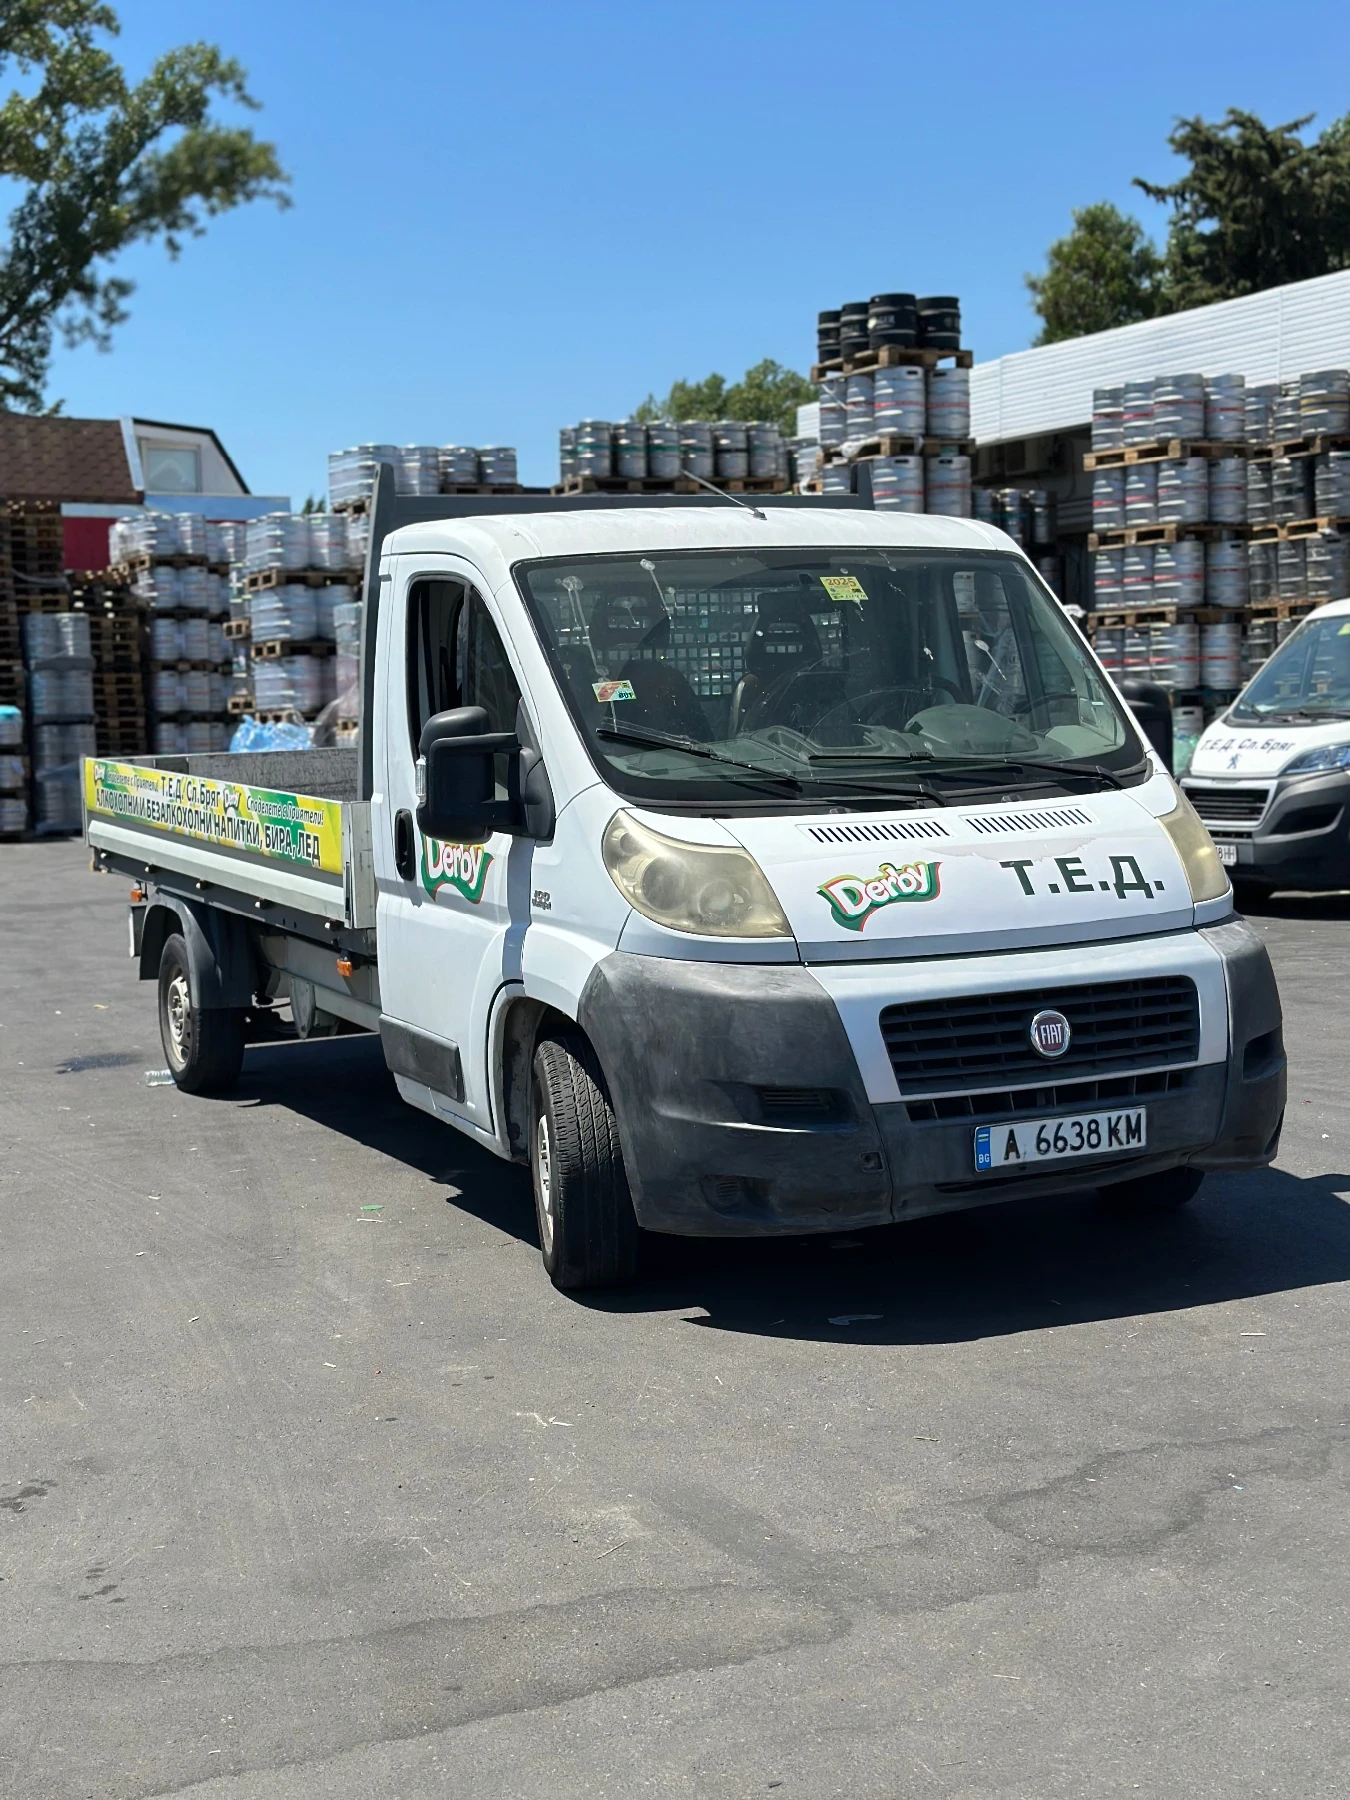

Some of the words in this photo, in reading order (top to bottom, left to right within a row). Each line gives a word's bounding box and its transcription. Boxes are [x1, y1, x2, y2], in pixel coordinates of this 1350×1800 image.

[825, 577, 857, 588] 2025
[96, 787, 138, 815] АЛКОХОЛНИ
[139, 797, 146, 817] И
[147, 799, 212, 834] БЕЗАЛКОХОЛНИ
[214, 814, 262, 849] НАПИТКИ,
[265, 825, 296, 858] БИРА,
[298, 831, 321, 867] ЛЕД
[825, 863, 928, 916] Derby
[999, 855, 1165, 900] Т.Е.Д.
[1040, 1023, 1062, 1045] FIAT
[978, 1153, 990, 1164] BG
[1003, 1128, 1021, 1161] A
[1035, 1118, 1102, 1156] 6638
[1107, 1112, 1142, 1148] KM
